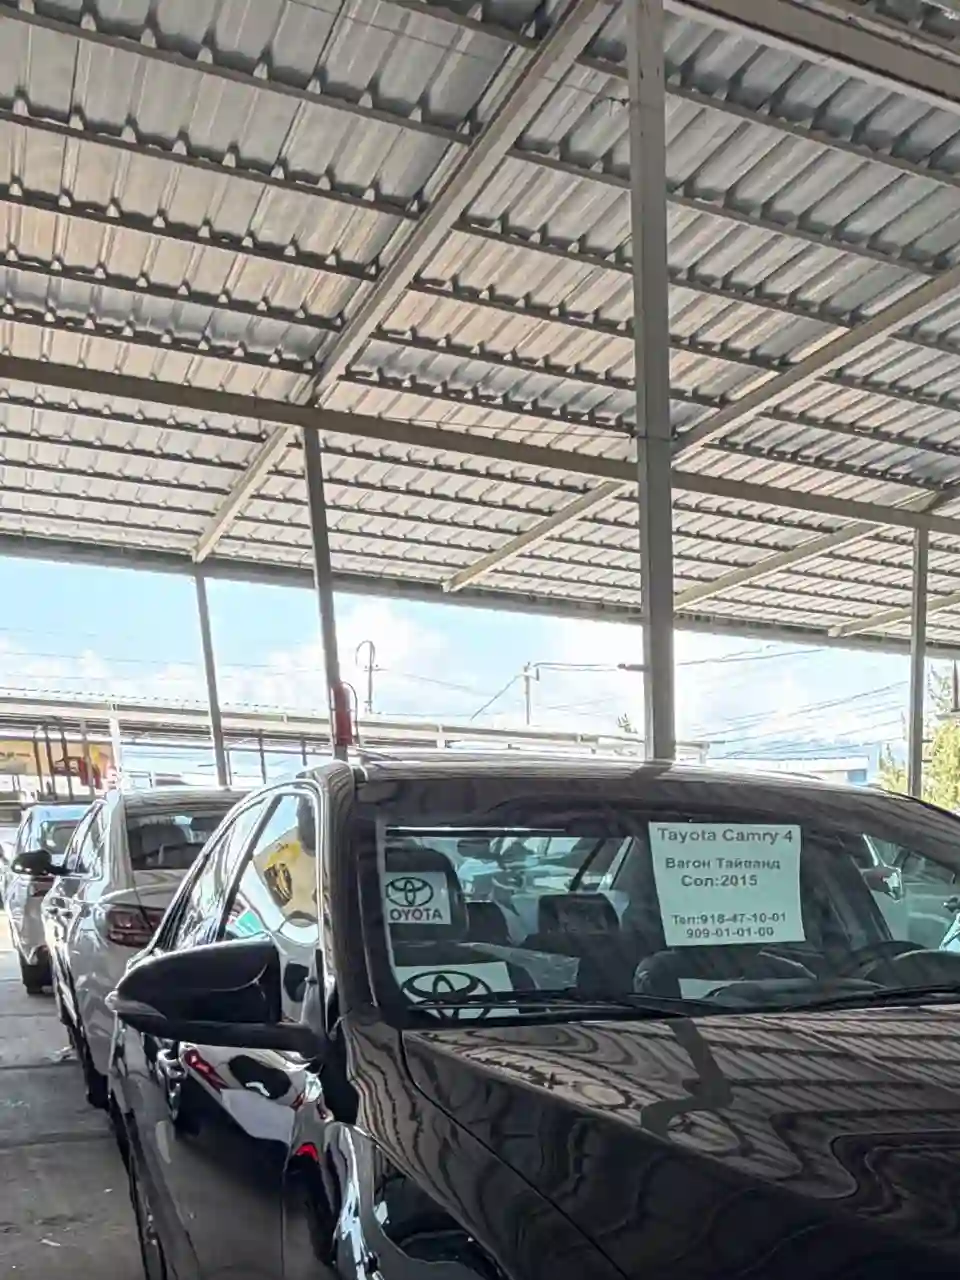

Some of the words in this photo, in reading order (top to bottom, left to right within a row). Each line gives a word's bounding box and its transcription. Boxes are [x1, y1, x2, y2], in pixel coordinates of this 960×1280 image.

[657, 827, 717, 844] Tayota
[722, 828, 779, 845] Camry
[782, 829, 794, 843] 4
[665, 857, 711, 869] Вагон
[390, 908, 443, 921] OYOTA
